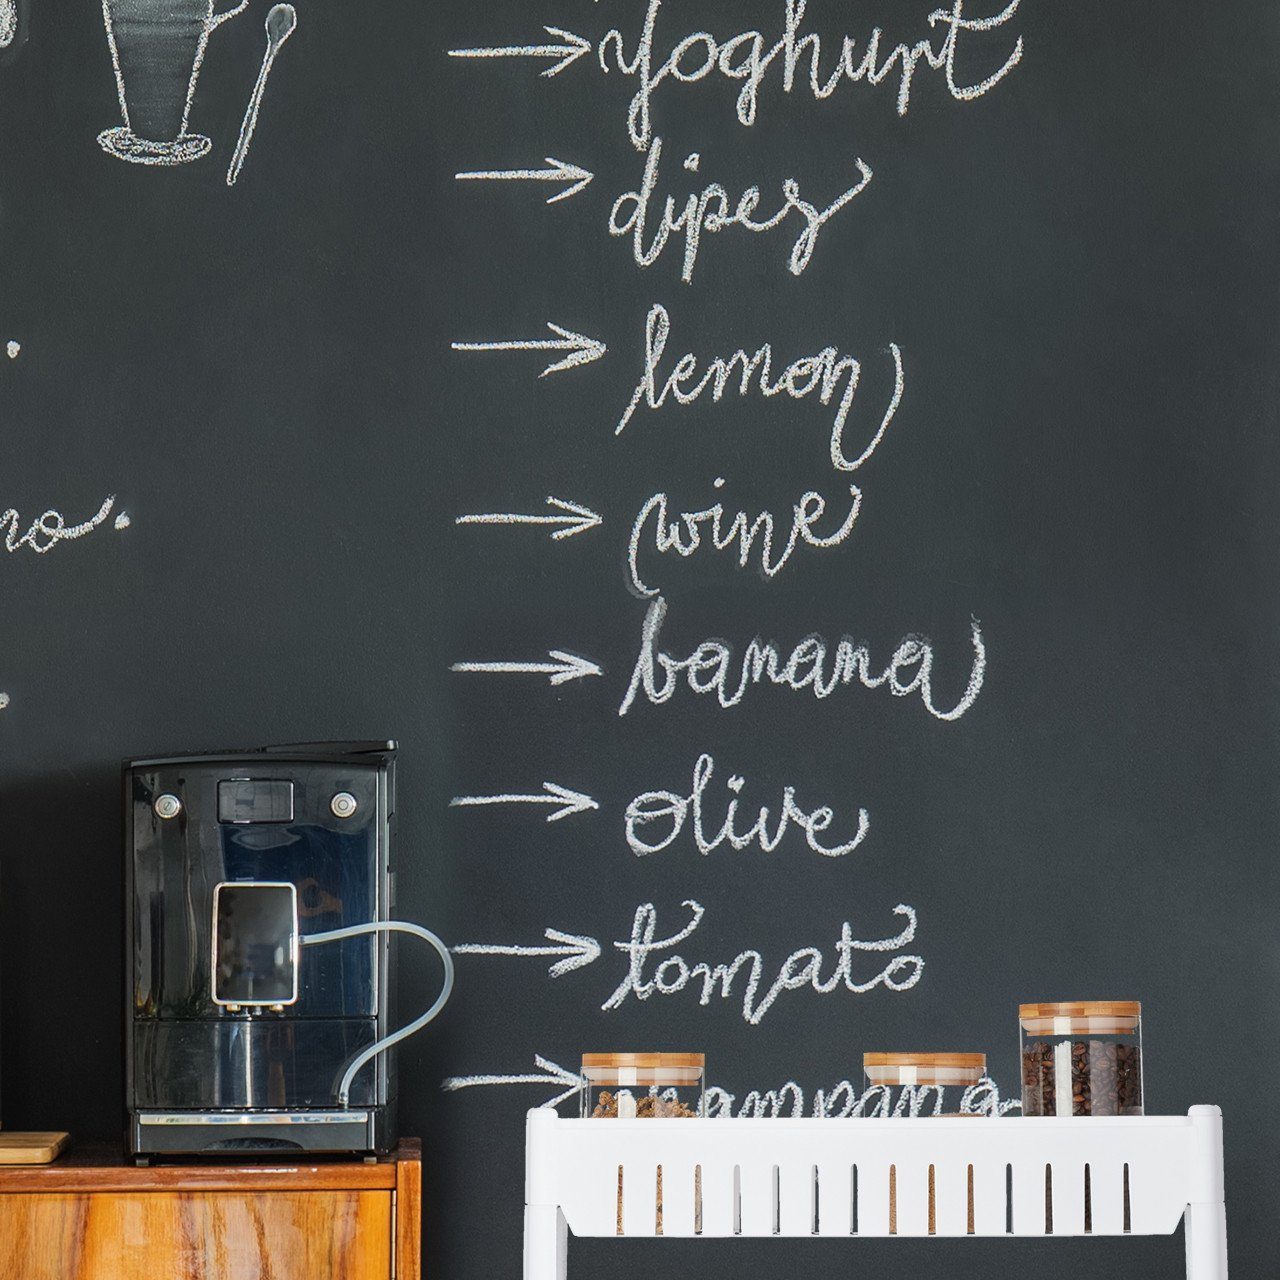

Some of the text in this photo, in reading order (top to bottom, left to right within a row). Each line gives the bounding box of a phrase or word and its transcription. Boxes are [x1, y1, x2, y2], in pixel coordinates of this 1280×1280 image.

[615, 304, 904, 471] lemon
[624, 478, 862, 595] wine
[618, 597, 986, 721] banana
[625, 754, 869, 857] olive
[601, 899, 925, 1024] tomato
